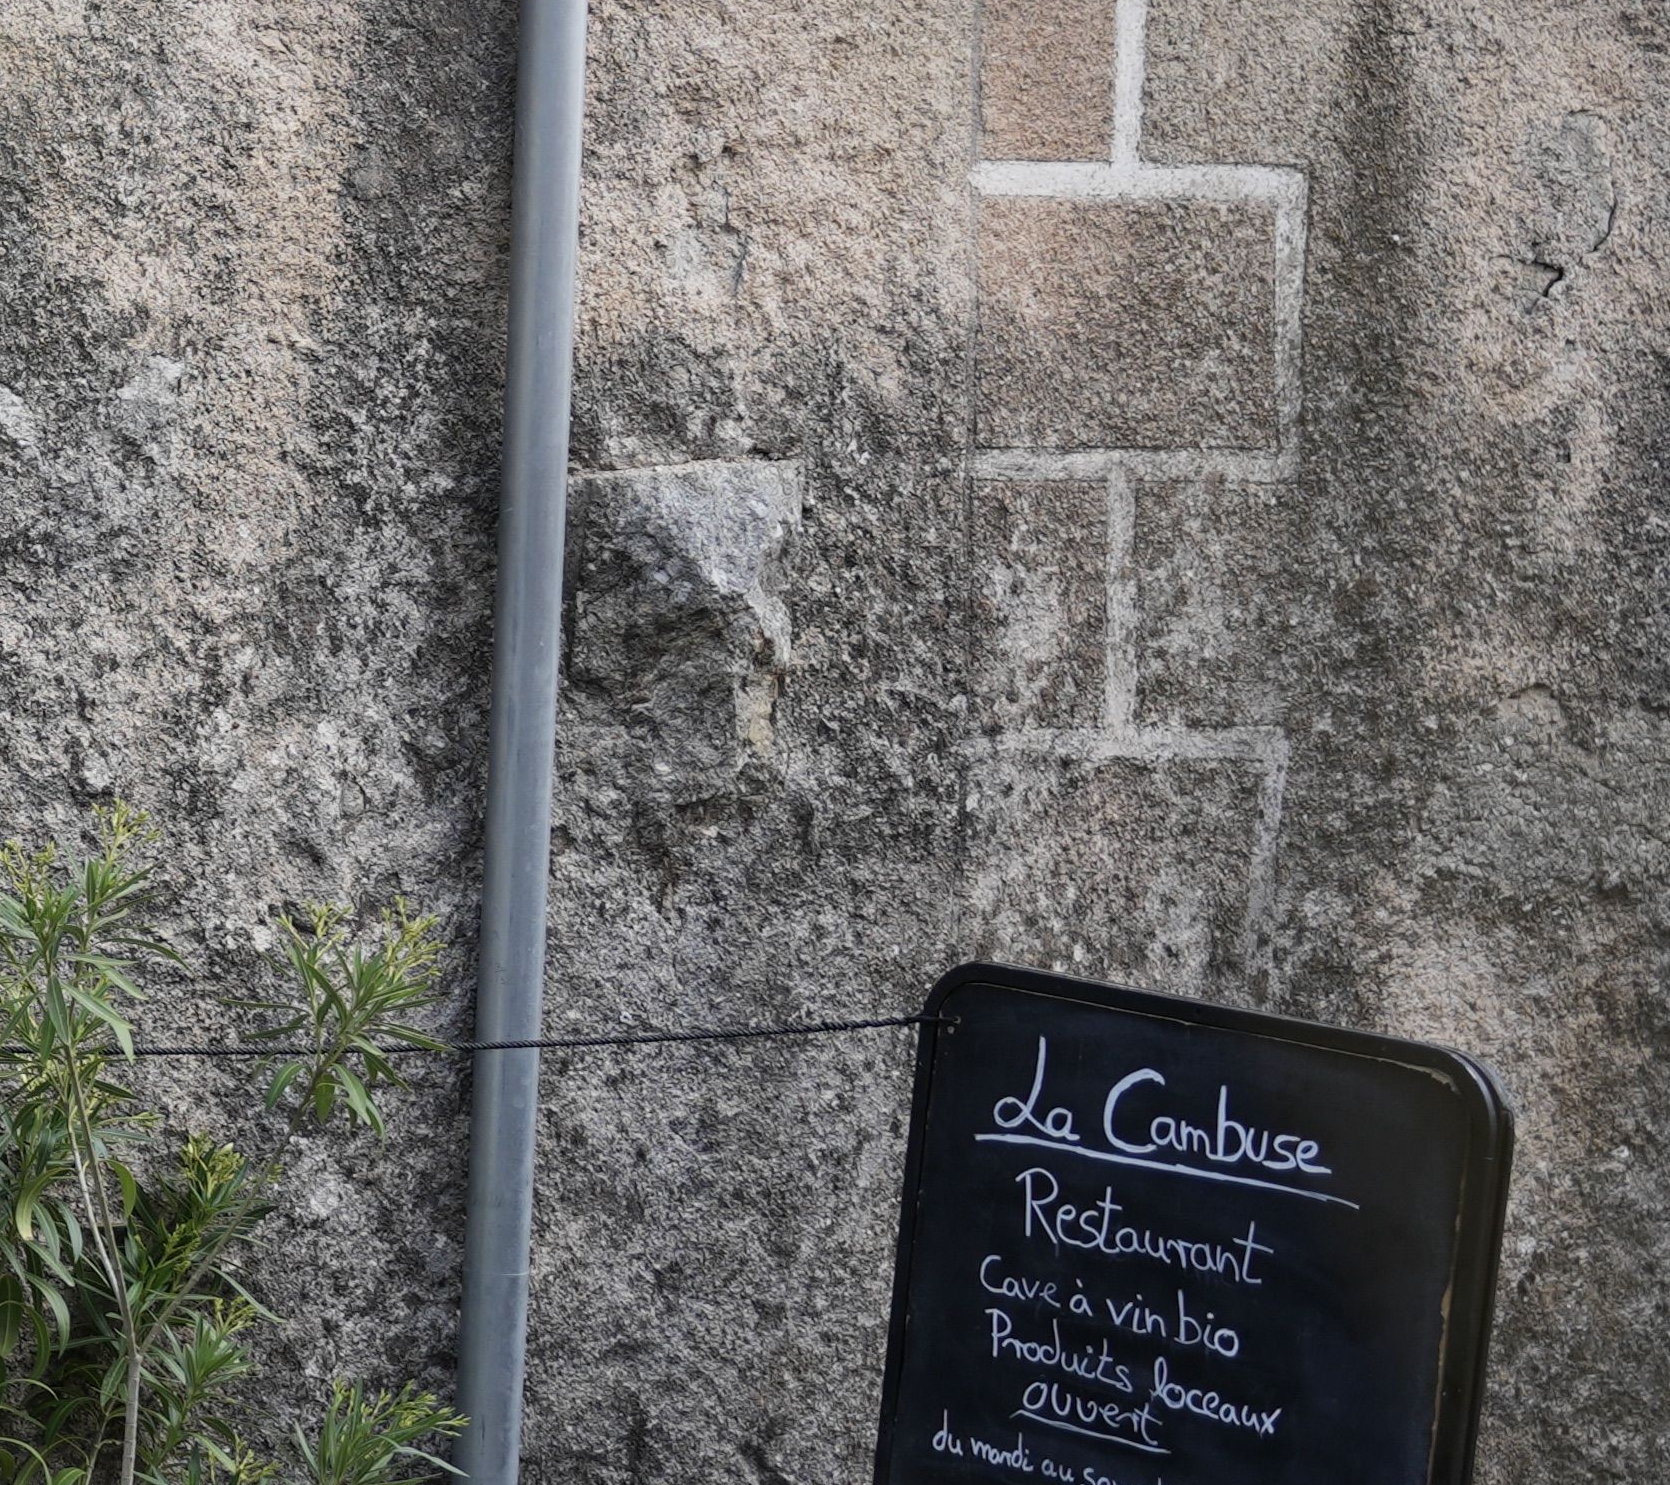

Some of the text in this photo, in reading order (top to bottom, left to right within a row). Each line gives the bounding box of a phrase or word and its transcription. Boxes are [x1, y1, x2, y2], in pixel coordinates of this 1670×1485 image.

[993, 1035, 1332, 1176] La Cambuse
[1015, 1167, 1274, 1285] Restaurant
[979, 1254, 1240, 1358] Cave à vin bio
[984, 1308, 1133, 1393] Produits
[932, 1408, 963, 1456] du
[970, 1431, 1034, 1472] mardi
[1040, 1458, 1075, 1483] au
